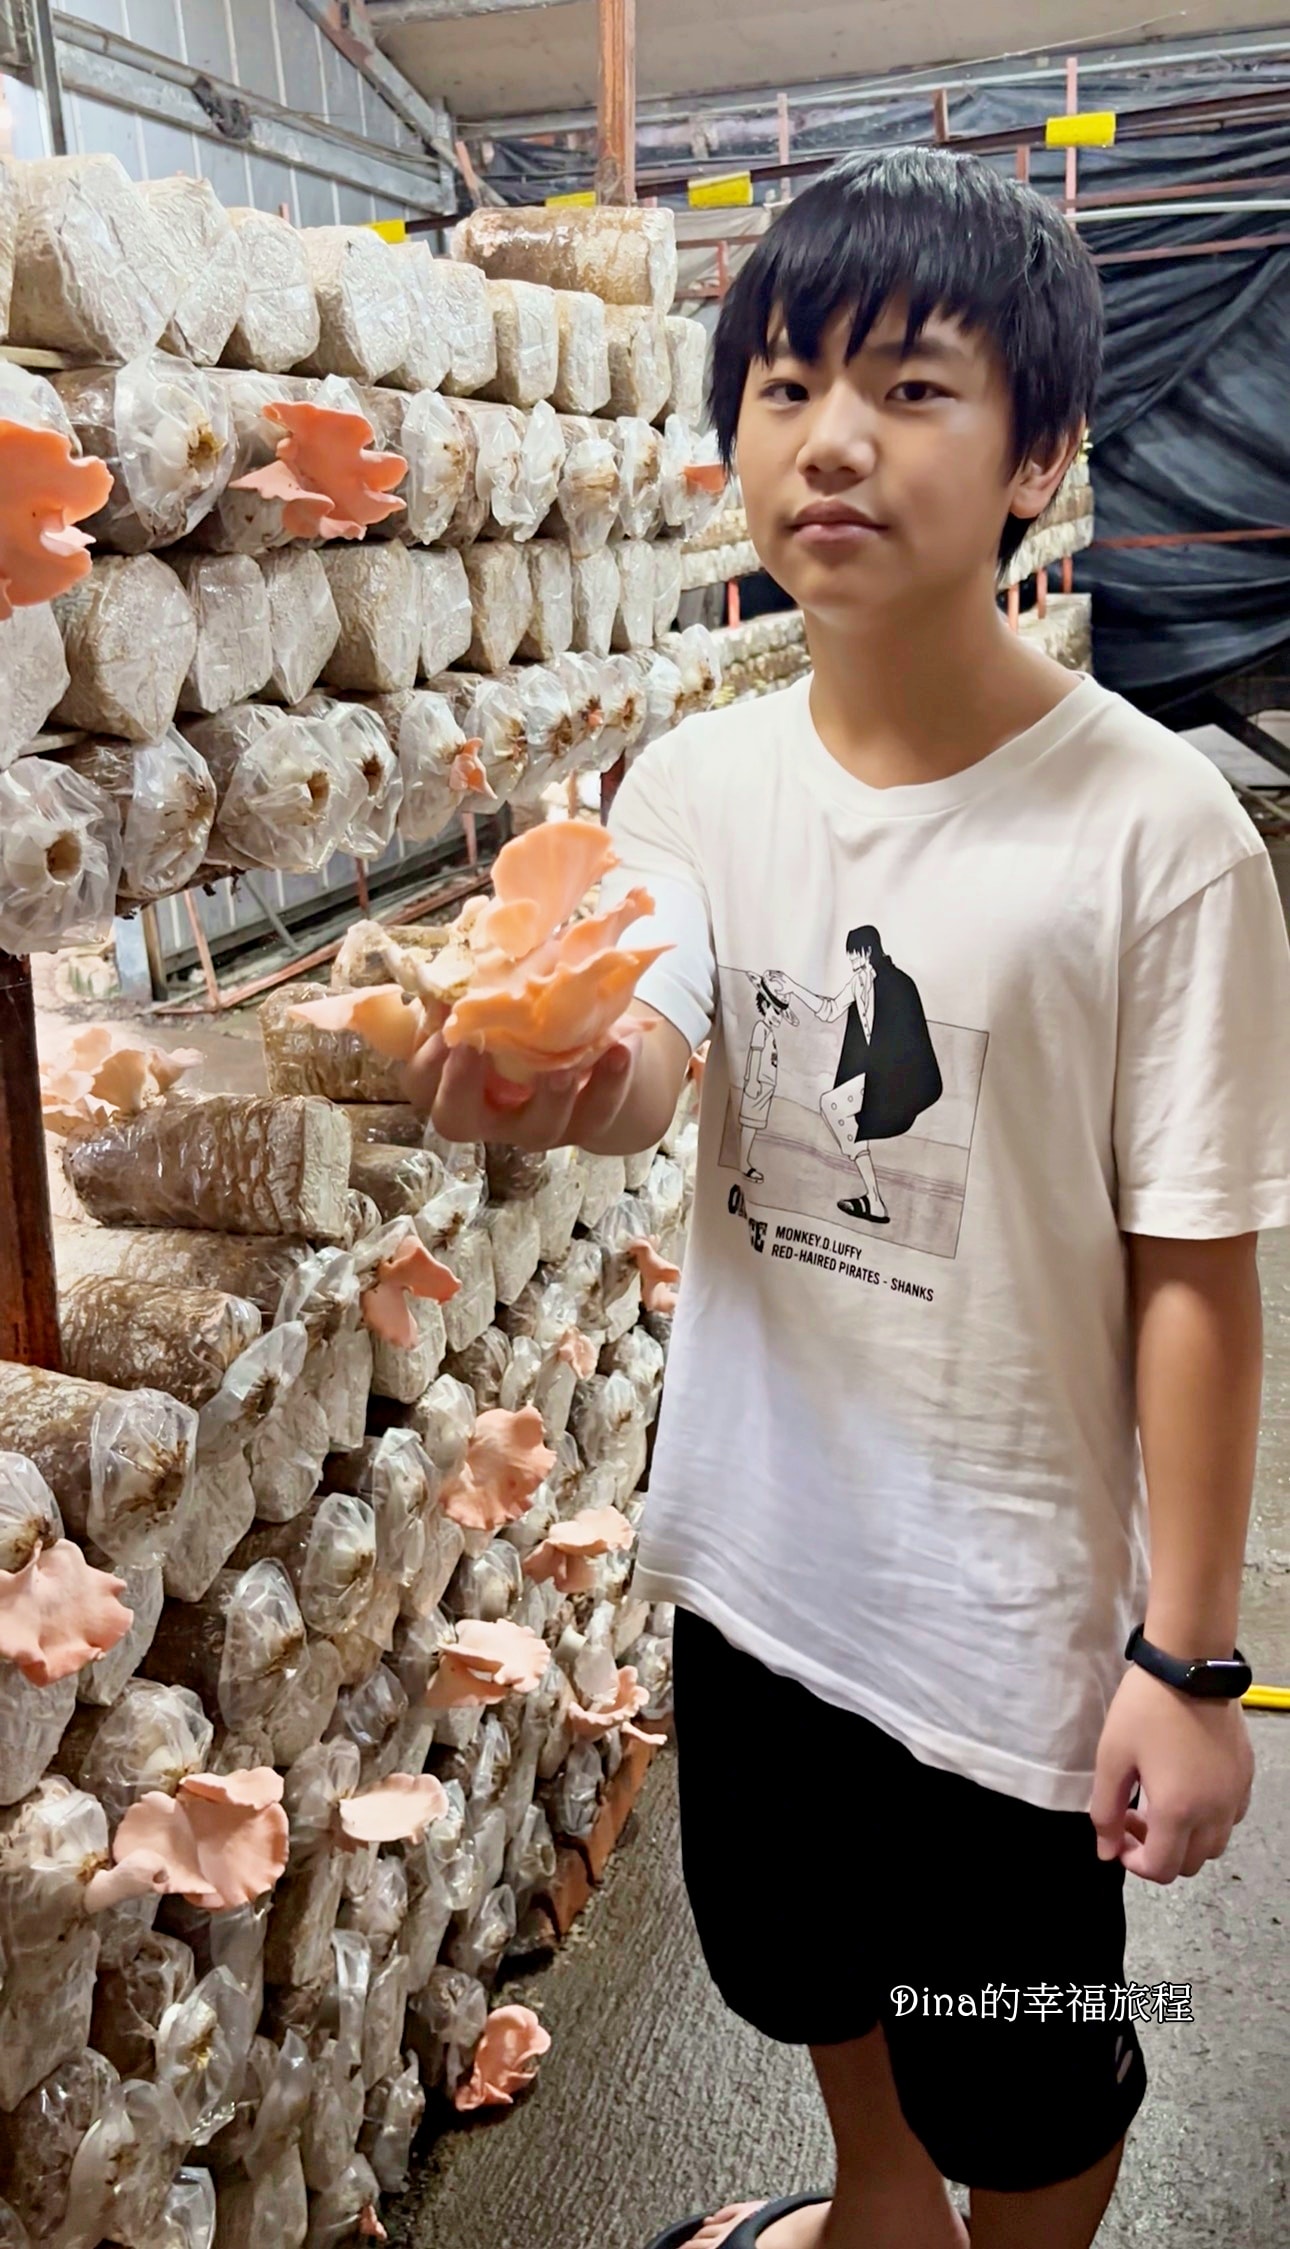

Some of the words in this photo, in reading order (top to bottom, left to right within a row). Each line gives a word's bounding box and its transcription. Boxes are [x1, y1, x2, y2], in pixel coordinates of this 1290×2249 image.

[775, 1225, 862, 1260] MONKEY.D.LUFFY
[771, 1243, 837, 1271] RED-HAIRED
[838, 1261, 880, 1285] PIRATES
[890, 1277, 934, 1302] SHANKS
